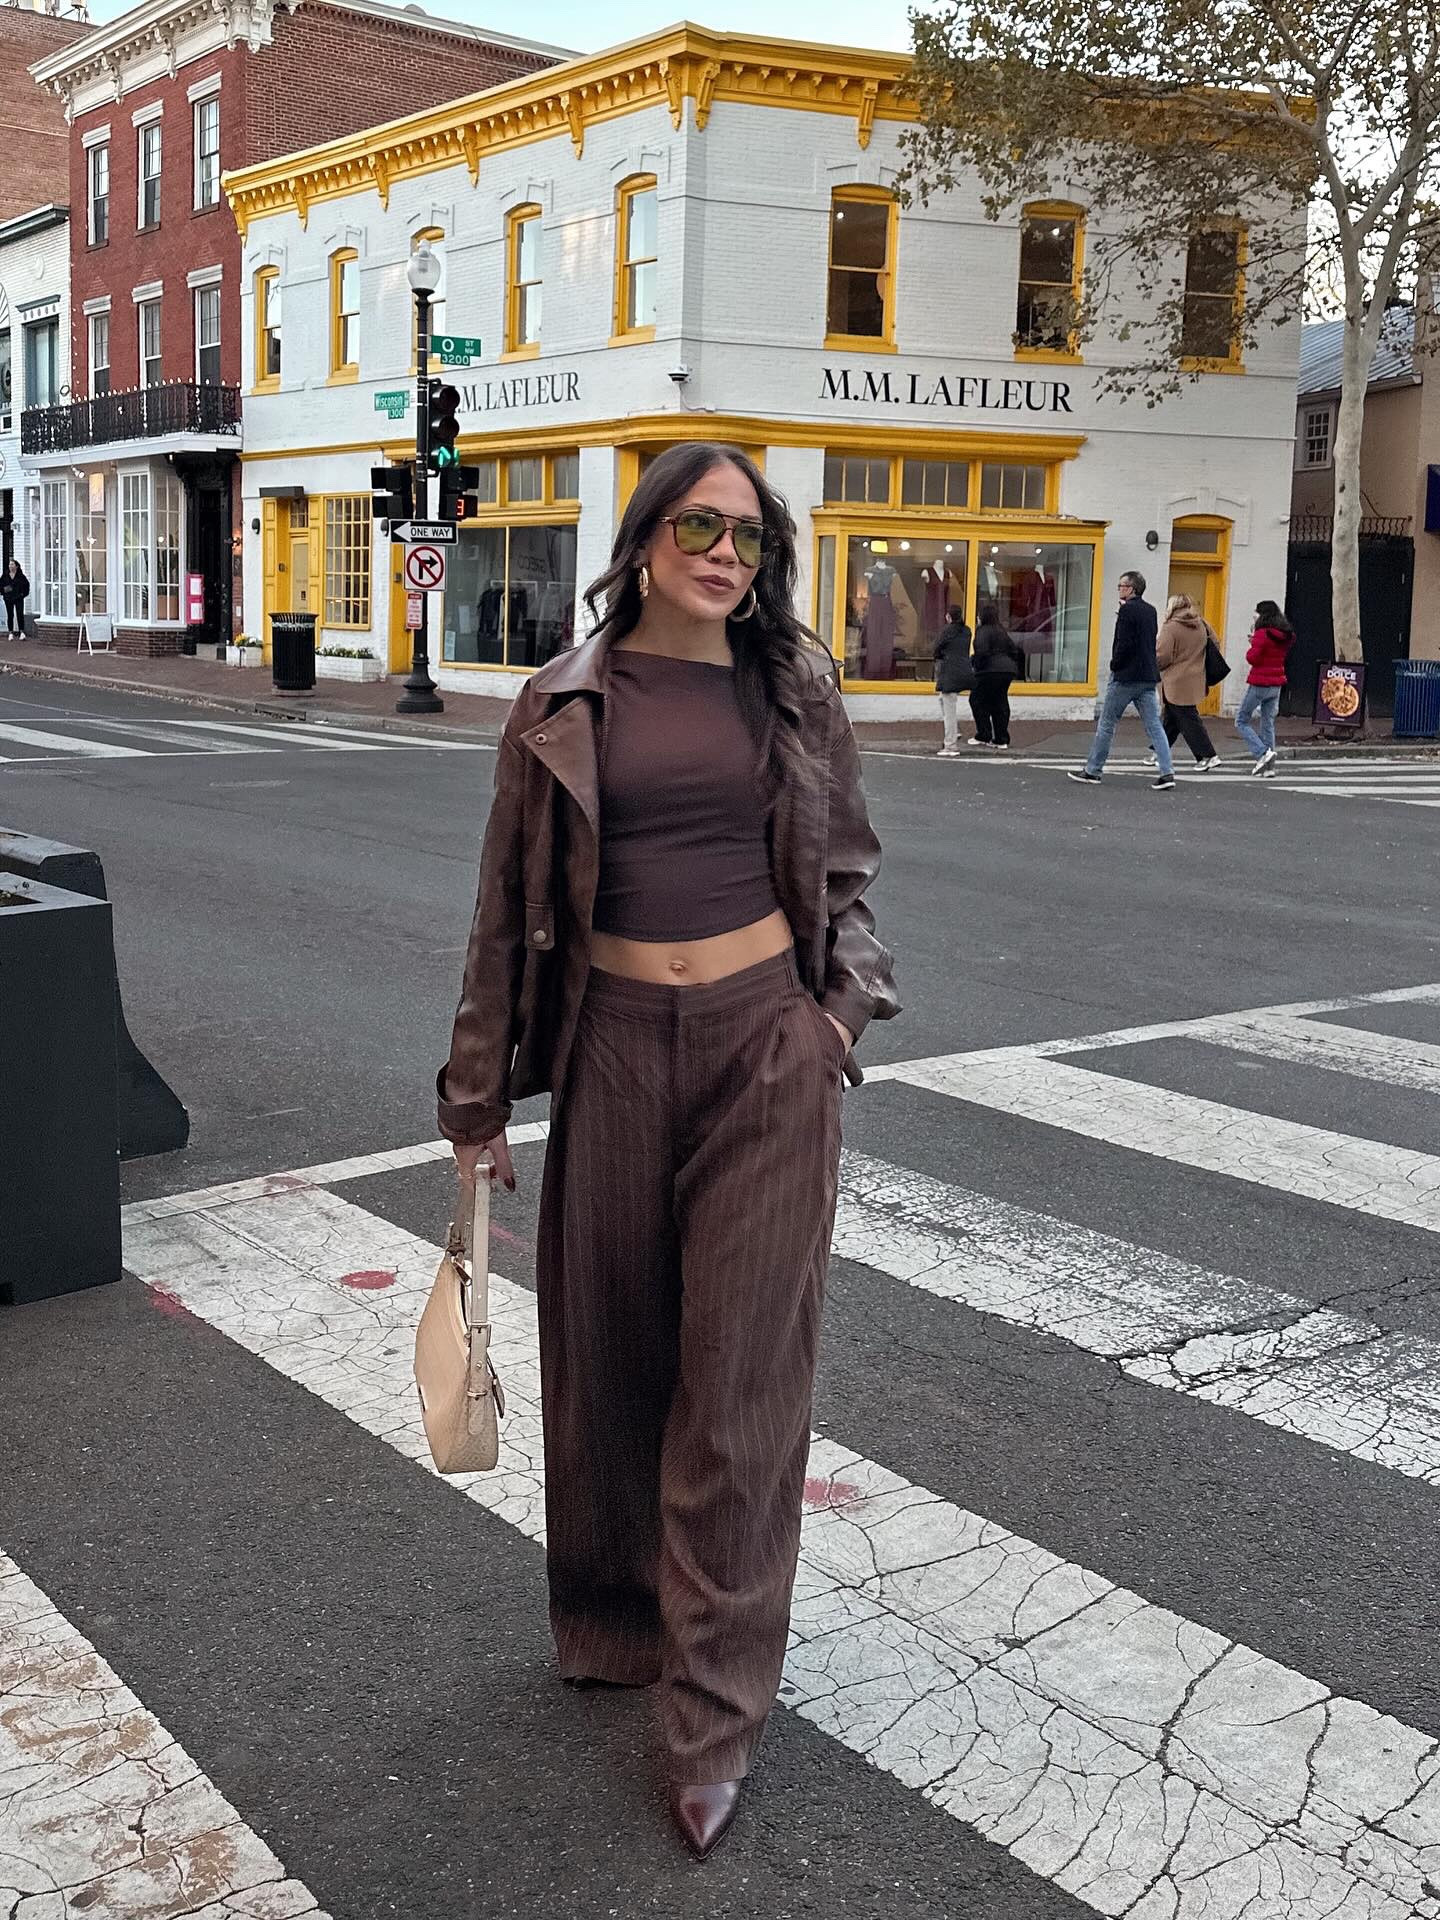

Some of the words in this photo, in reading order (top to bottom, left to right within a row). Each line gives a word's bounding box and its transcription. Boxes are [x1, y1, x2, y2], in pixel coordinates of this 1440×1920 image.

[442, 338, 454, 353] O
[442, 354, 469, 365] 3200
[485, 371, 581, 411] LAFLEUR
[818, 367, 900, 404] M.M.
[906, 373, 1074, 413] LAFLEUR
[410, 527, 429, 537] ONE
[431, 527, 450, 537] WAY
[1327, 670, 1356, 681] DOLCE
